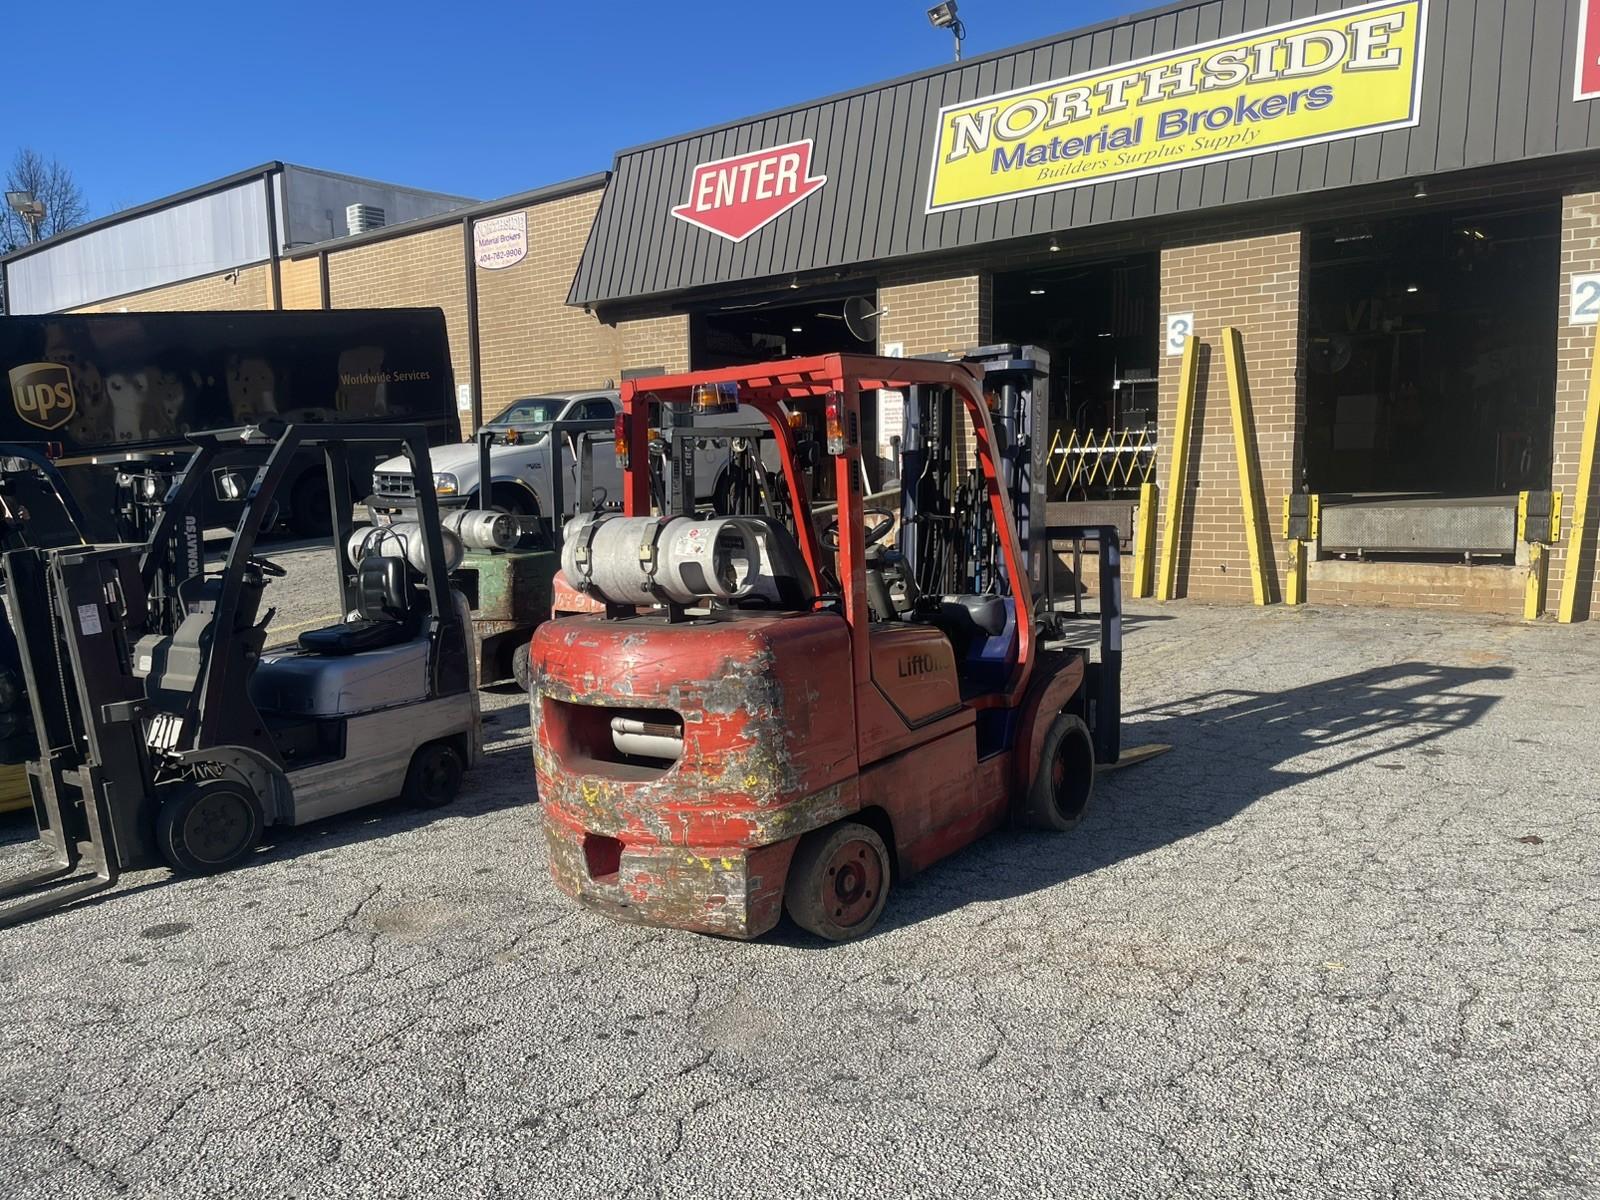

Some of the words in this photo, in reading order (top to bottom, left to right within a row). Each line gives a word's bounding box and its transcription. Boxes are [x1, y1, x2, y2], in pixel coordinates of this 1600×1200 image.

[946, 11, 1405, 164] NORTHSIDE
[991, 117, 1144, 174] Material
[1156, 84, 1334, 141] Brokers
[1037, 158, 1108, 181] Builders
[1113, 142, 1185, 166] Surplus
[1191, 126, 1261, 151] Supply
[696, 152, 801, 213] ENTER
[500, 233, 521, 243] Brokers
[1575, 281, 1600, 315] 2
[1170, 319, 1189, 348] 3
[340, 372, 392, 385] Worldwide
[393, 370, 431, 382] Services
[16, 382, 72, 420] ups
[184, 515, 199, 578] KOMATSU
